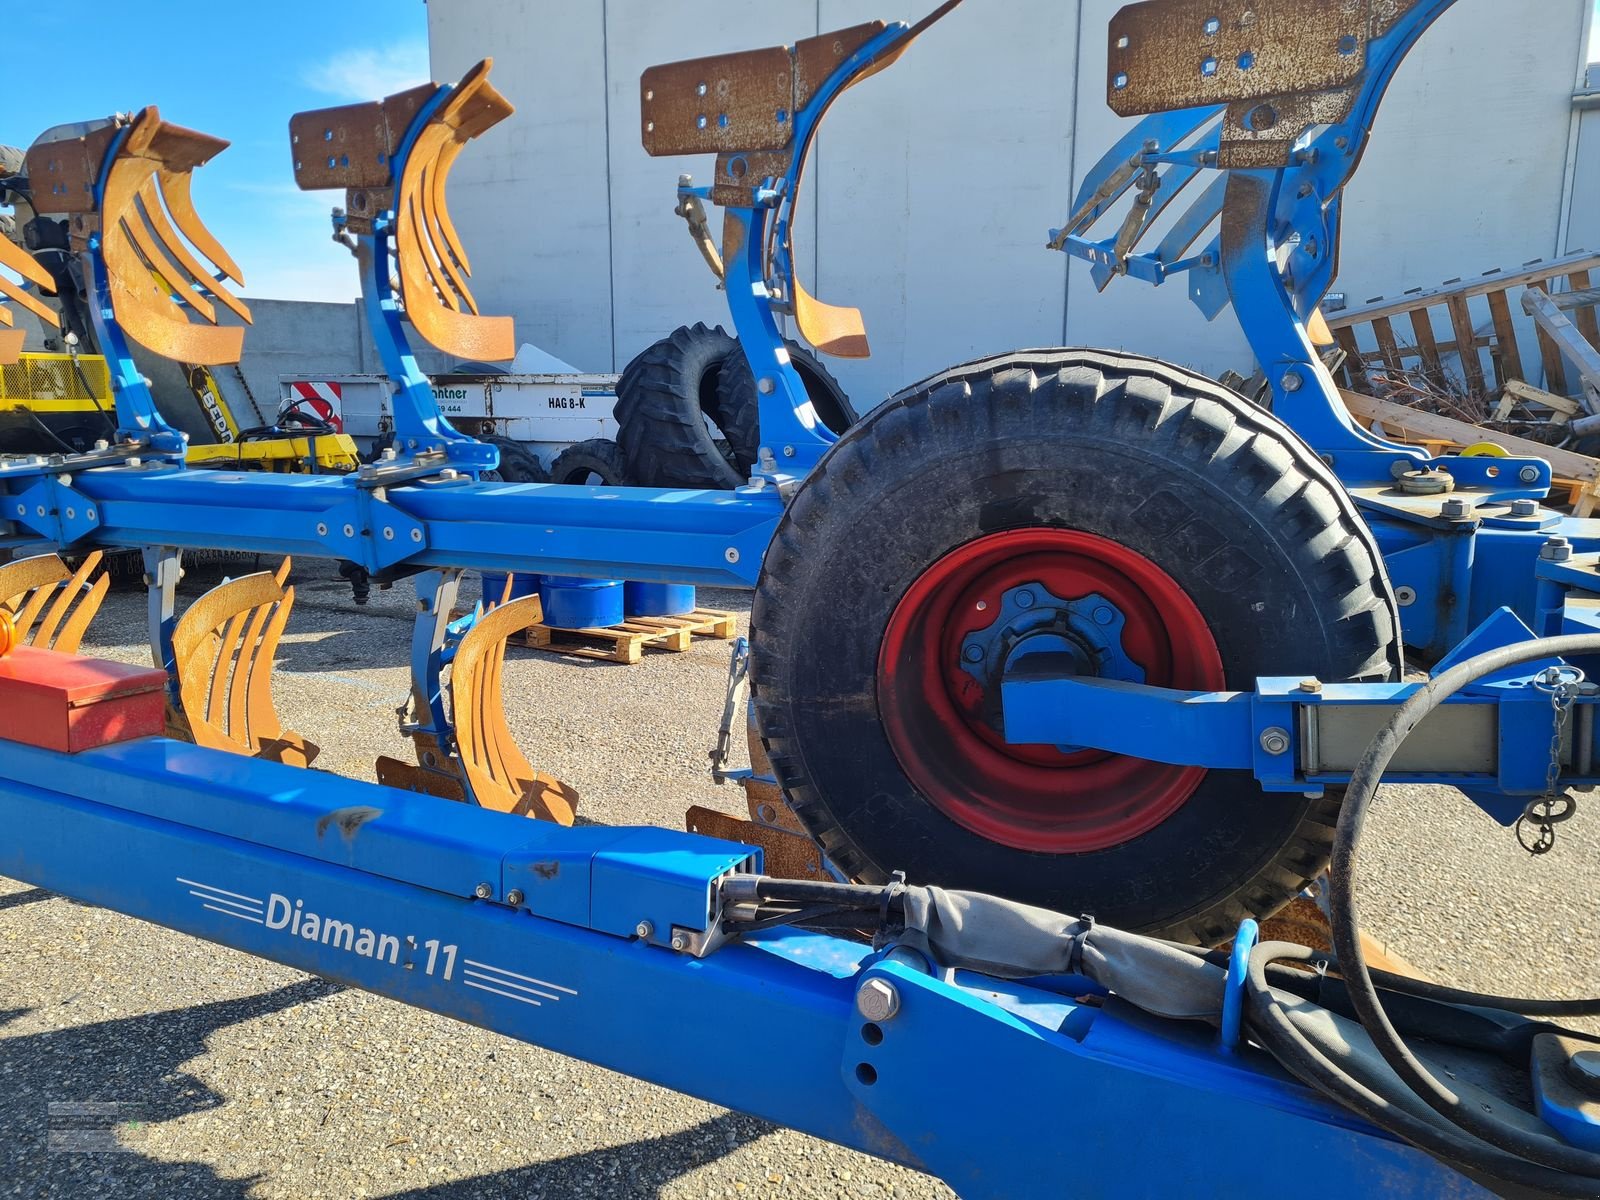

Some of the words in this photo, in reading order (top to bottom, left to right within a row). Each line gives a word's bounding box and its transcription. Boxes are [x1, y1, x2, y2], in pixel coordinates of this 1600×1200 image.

[548, 397, 567, 409] HAG
[569, 397, 586, 409] 8-K
[425, 939, 458, 981] 11
